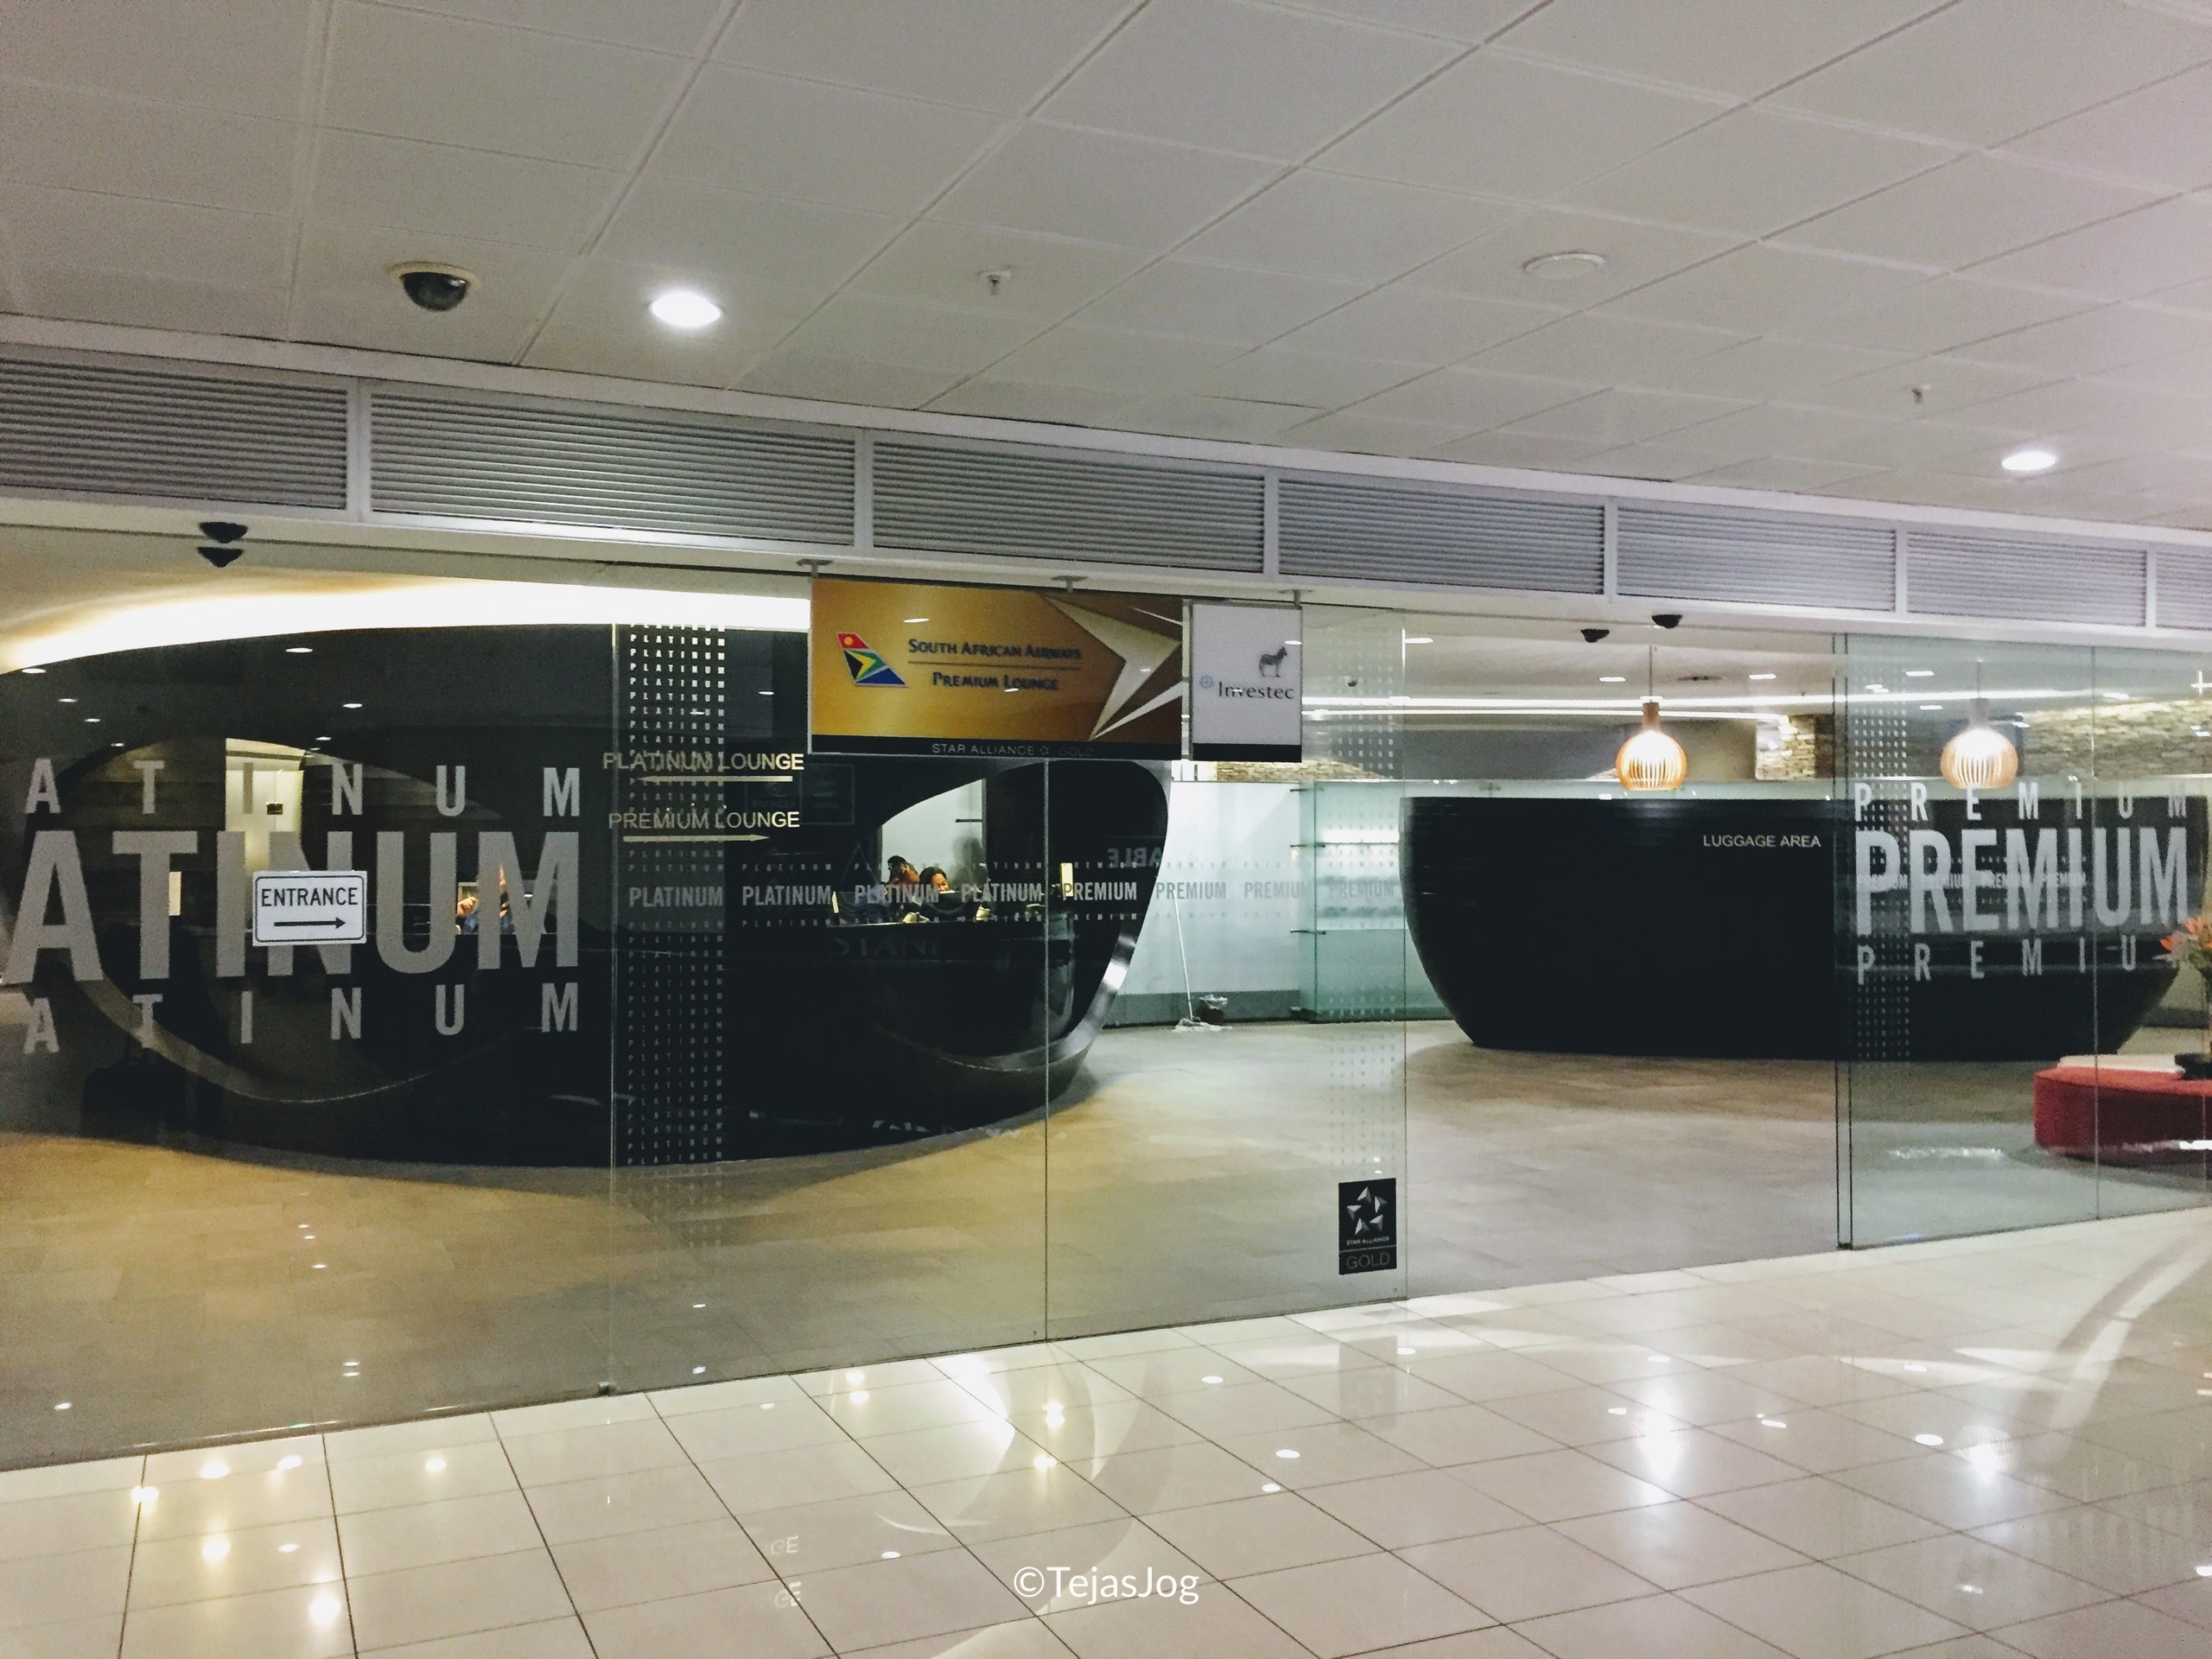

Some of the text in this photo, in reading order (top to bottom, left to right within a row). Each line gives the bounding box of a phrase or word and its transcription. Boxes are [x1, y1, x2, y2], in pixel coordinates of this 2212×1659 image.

[909, 639, 957, 653] SOUTH
[961, 642, 1021, 657] AFRICAN
[932, 672, 1059, 690] PREMIUM LOUNGE
[1218, 681, 1295, 699] Investec
[931, 743, 1094, 757] STAR ALLIANCE GOLD
[603, 753, 714, 771] PLATINUM
[719, 753, 804, 771] LOUNGE
[608, 811, 710, 830] PREMIUM
[715, 810, 801, 829] LOUNGE
[1703, 835, 1821, 848] LUGGAGE AREA
[1855, 827, 2188, 936] PREMIUM
[262, 887, 358, 906] ENTRANCE
[629, 886, 723, 907] PLATINUM
[742, 885, 832, 906] PLATINUM
[855, 884, 939, 904] PLATINUM
[962, 882, 1042, 902] PLATINUM
[1063, 881, 1137, 901] PREMIUM
[1155, 880, 1227, 899] PREMIUM
[1346, 1252, 1390, 1269] GOLD
